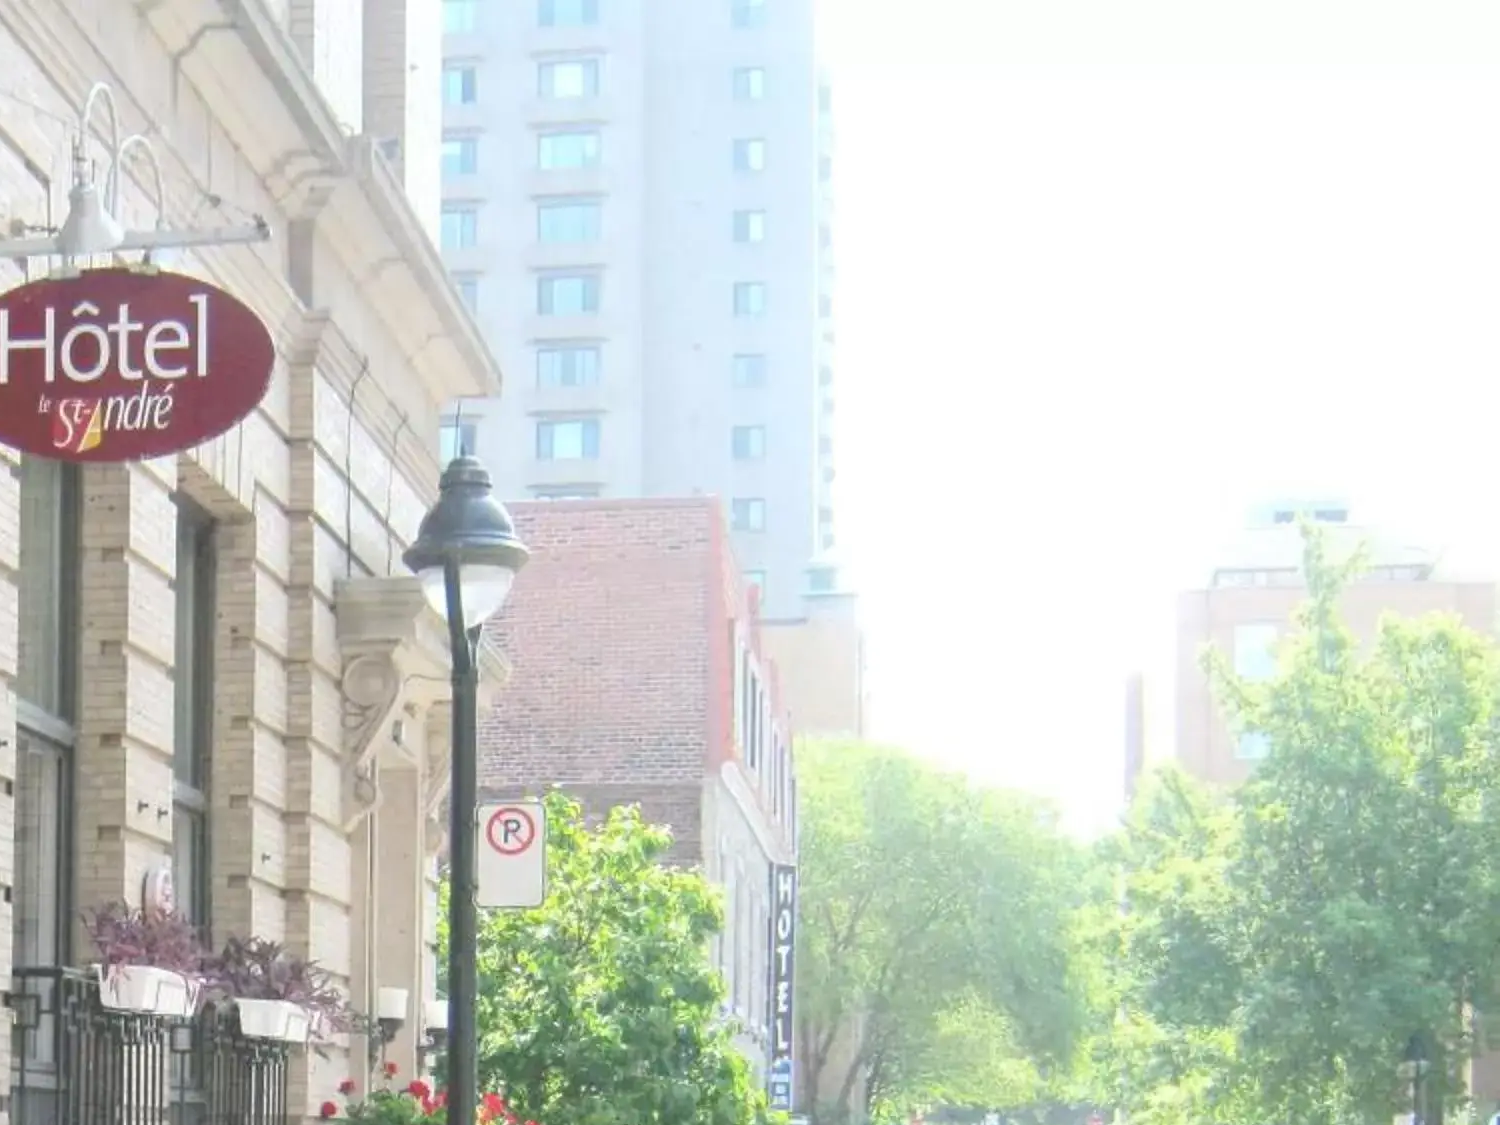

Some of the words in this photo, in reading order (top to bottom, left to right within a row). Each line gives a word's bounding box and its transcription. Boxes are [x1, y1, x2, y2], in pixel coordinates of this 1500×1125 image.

[37, 393, 53, 413] le
[503, 819, 521, 844] P
[776, 872, 794, 1052] HOTEL
